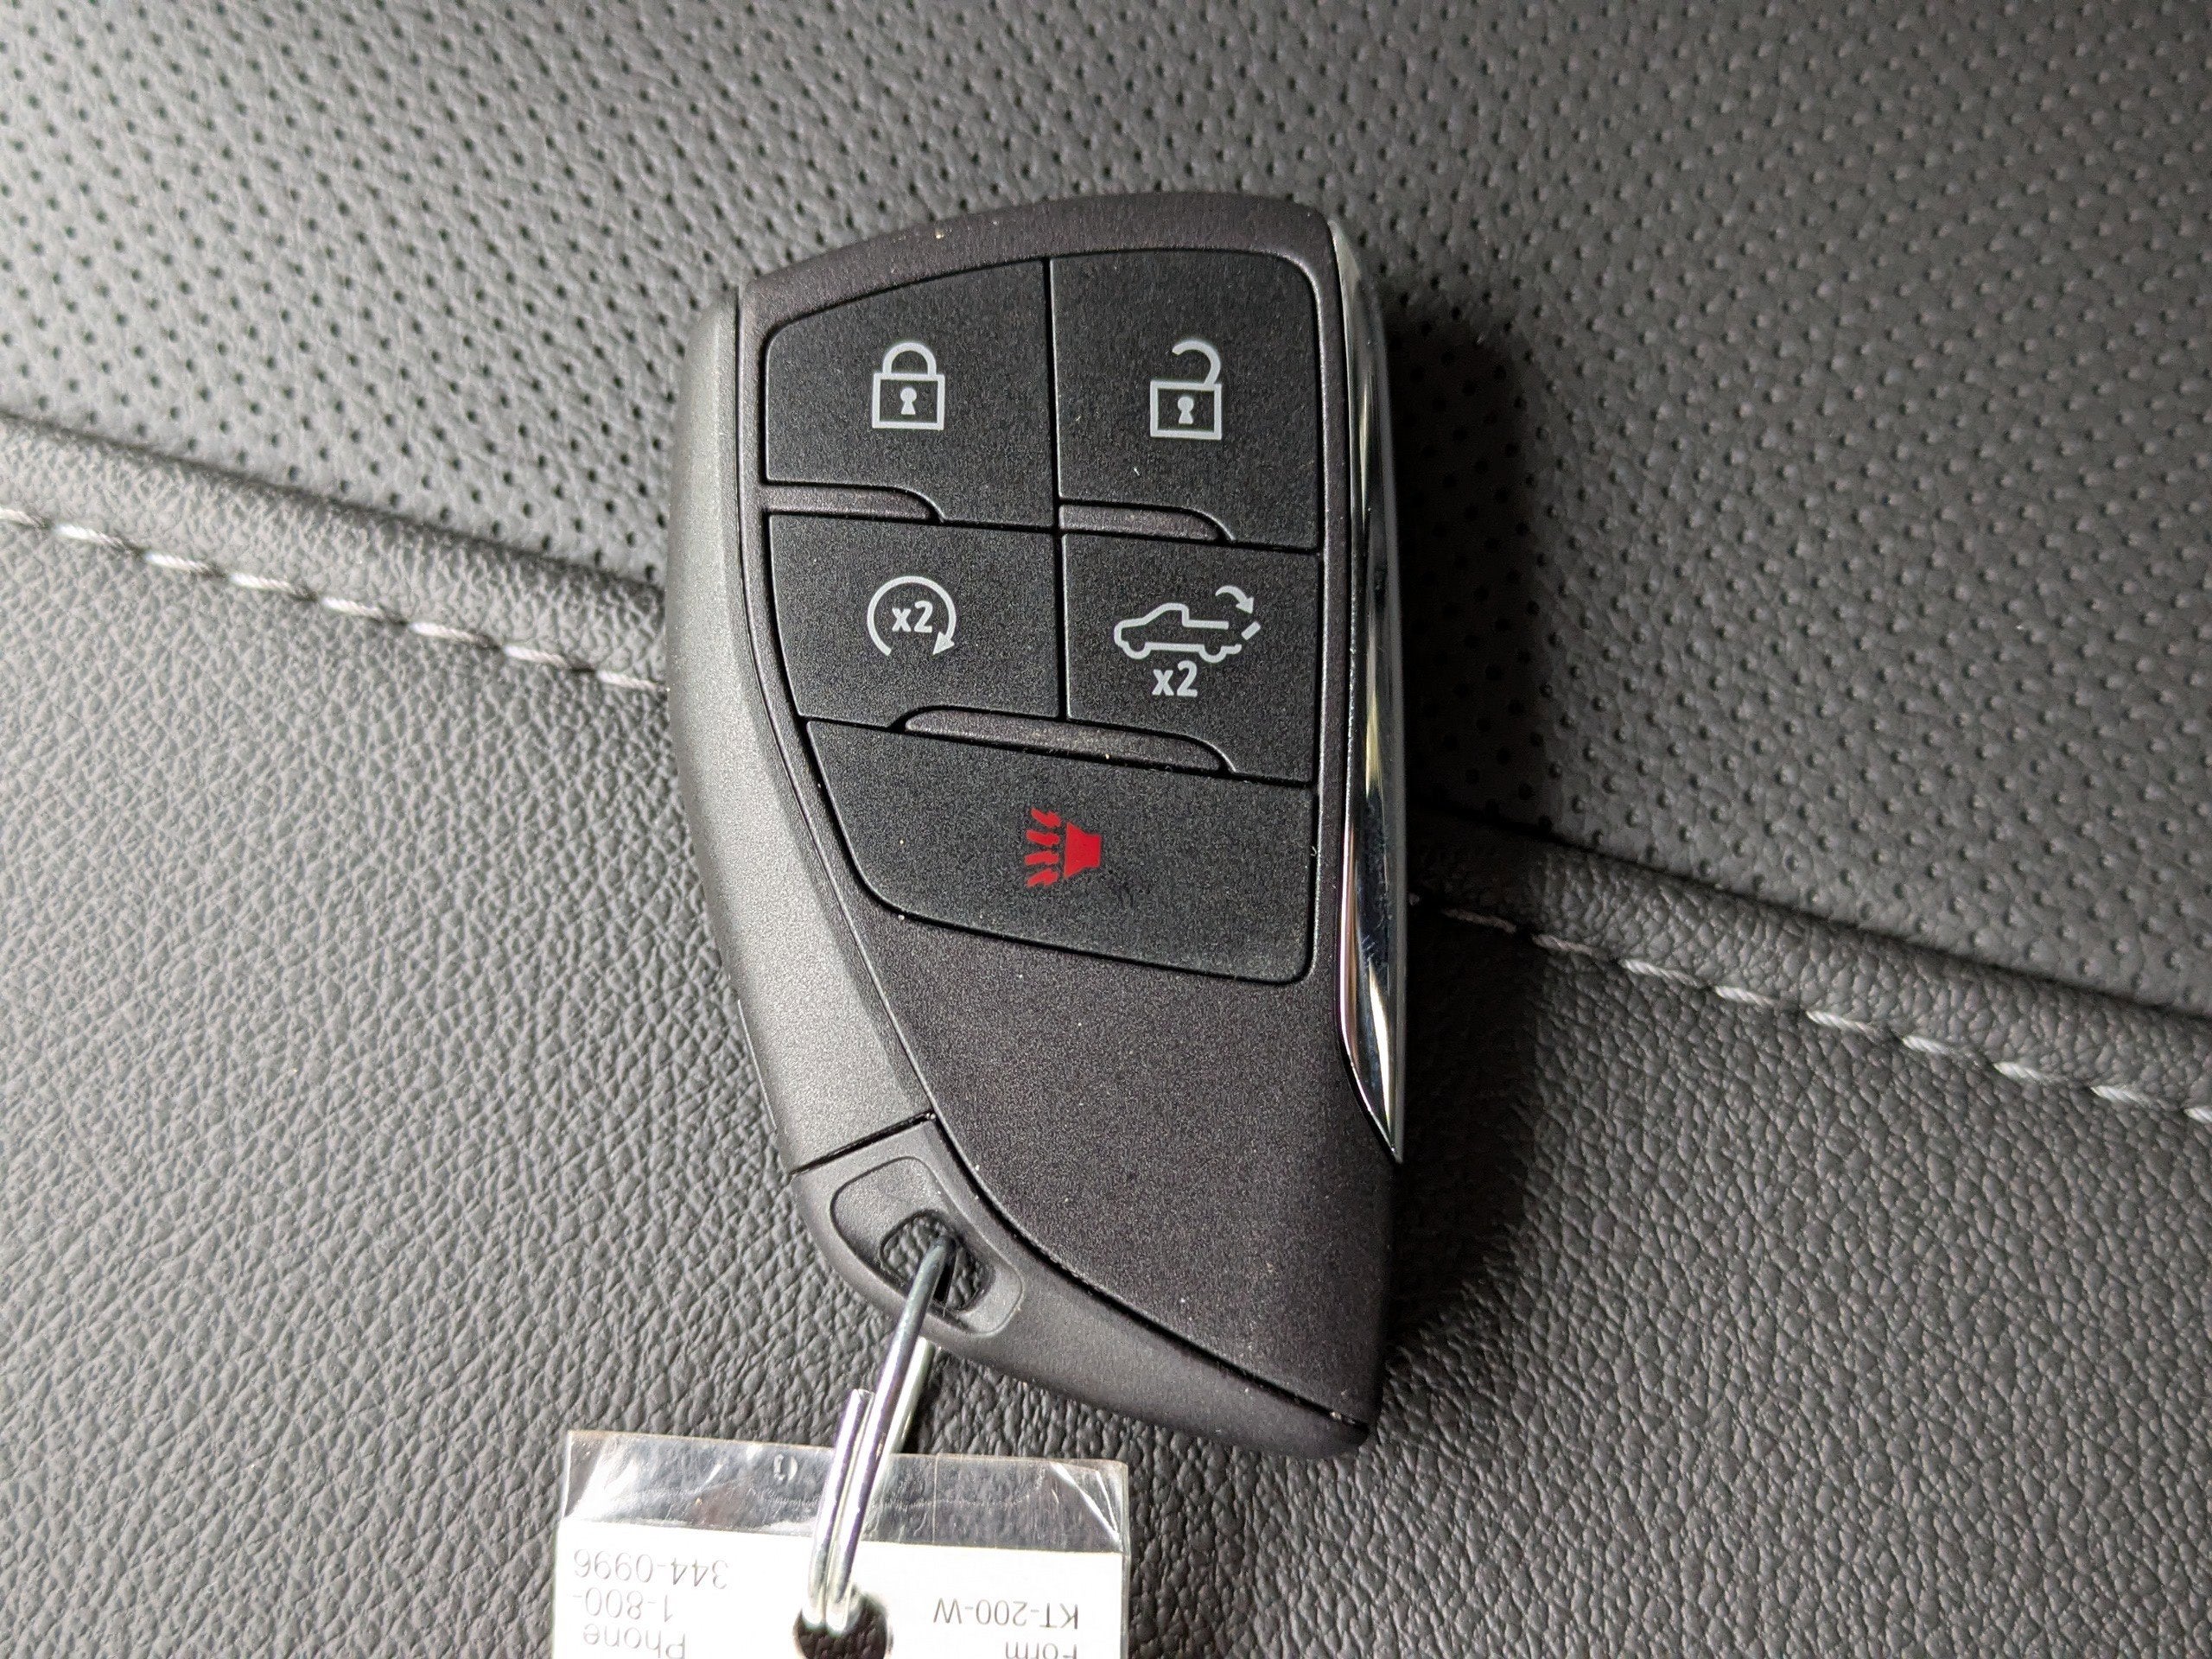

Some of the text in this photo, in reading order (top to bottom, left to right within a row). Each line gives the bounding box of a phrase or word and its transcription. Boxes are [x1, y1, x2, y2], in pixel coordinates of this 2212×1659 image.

[891, 600, 933, 633] x2
[1152, 659, 1198, 697] x2
[574, 1548, 728, 1589] 344-0996
[573, 1587, 673, 1623] 1-800-
[933, 1597, 1078, 1630] KT-200-W
[583, 1623, 685, 1659] Phone
